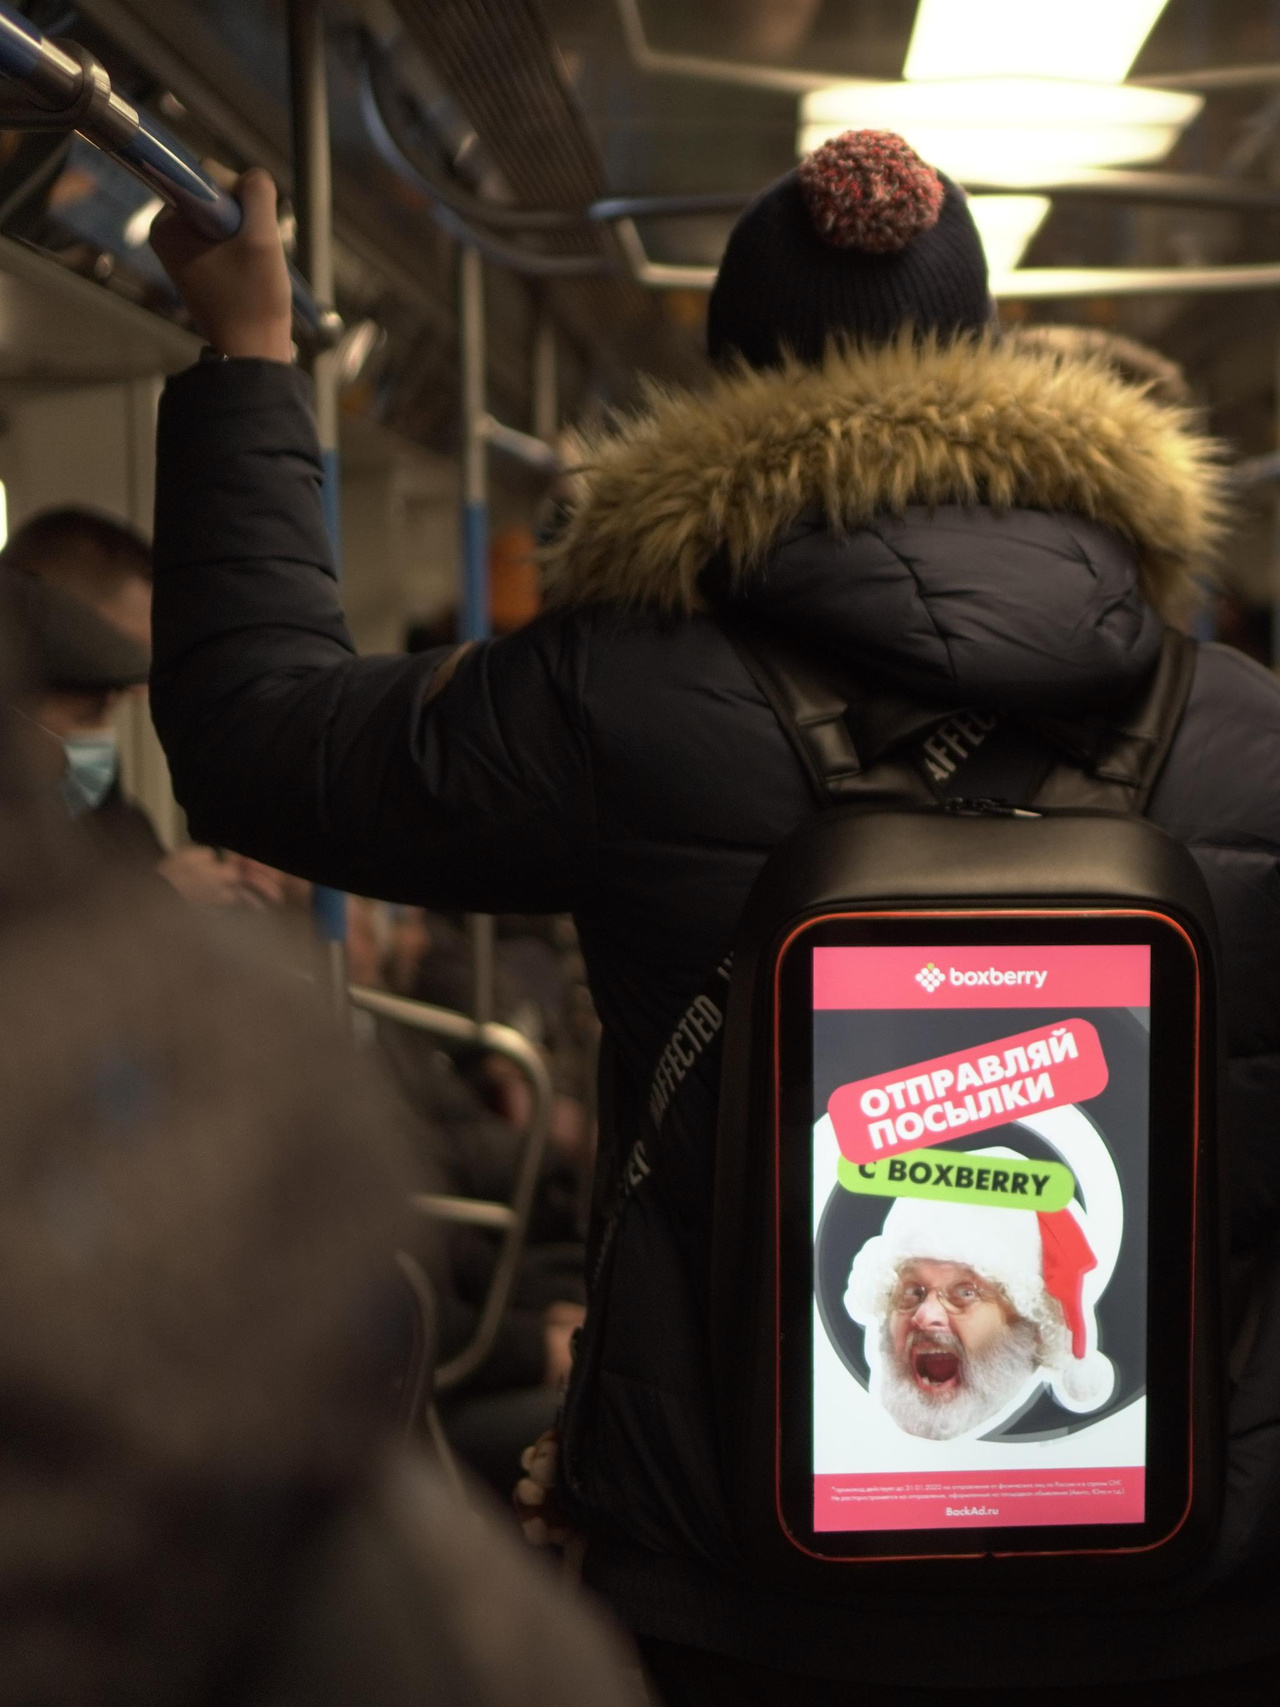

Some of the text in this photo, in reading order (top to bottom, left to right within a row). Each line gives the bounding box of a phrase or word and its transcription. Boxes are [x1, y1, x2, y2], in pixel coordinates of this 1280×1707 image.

[950, 967, 1048, 988] boxberry
[860, 1027, 1079, 1117] ОТПРАВЛЯЙ
[868, 1072, 1055, 1150] ПОСЫЛКИ
[887, 1159, 1051, 1196] BOXBERRY
[946, 1506, 999, 1517] BackAd.ru
